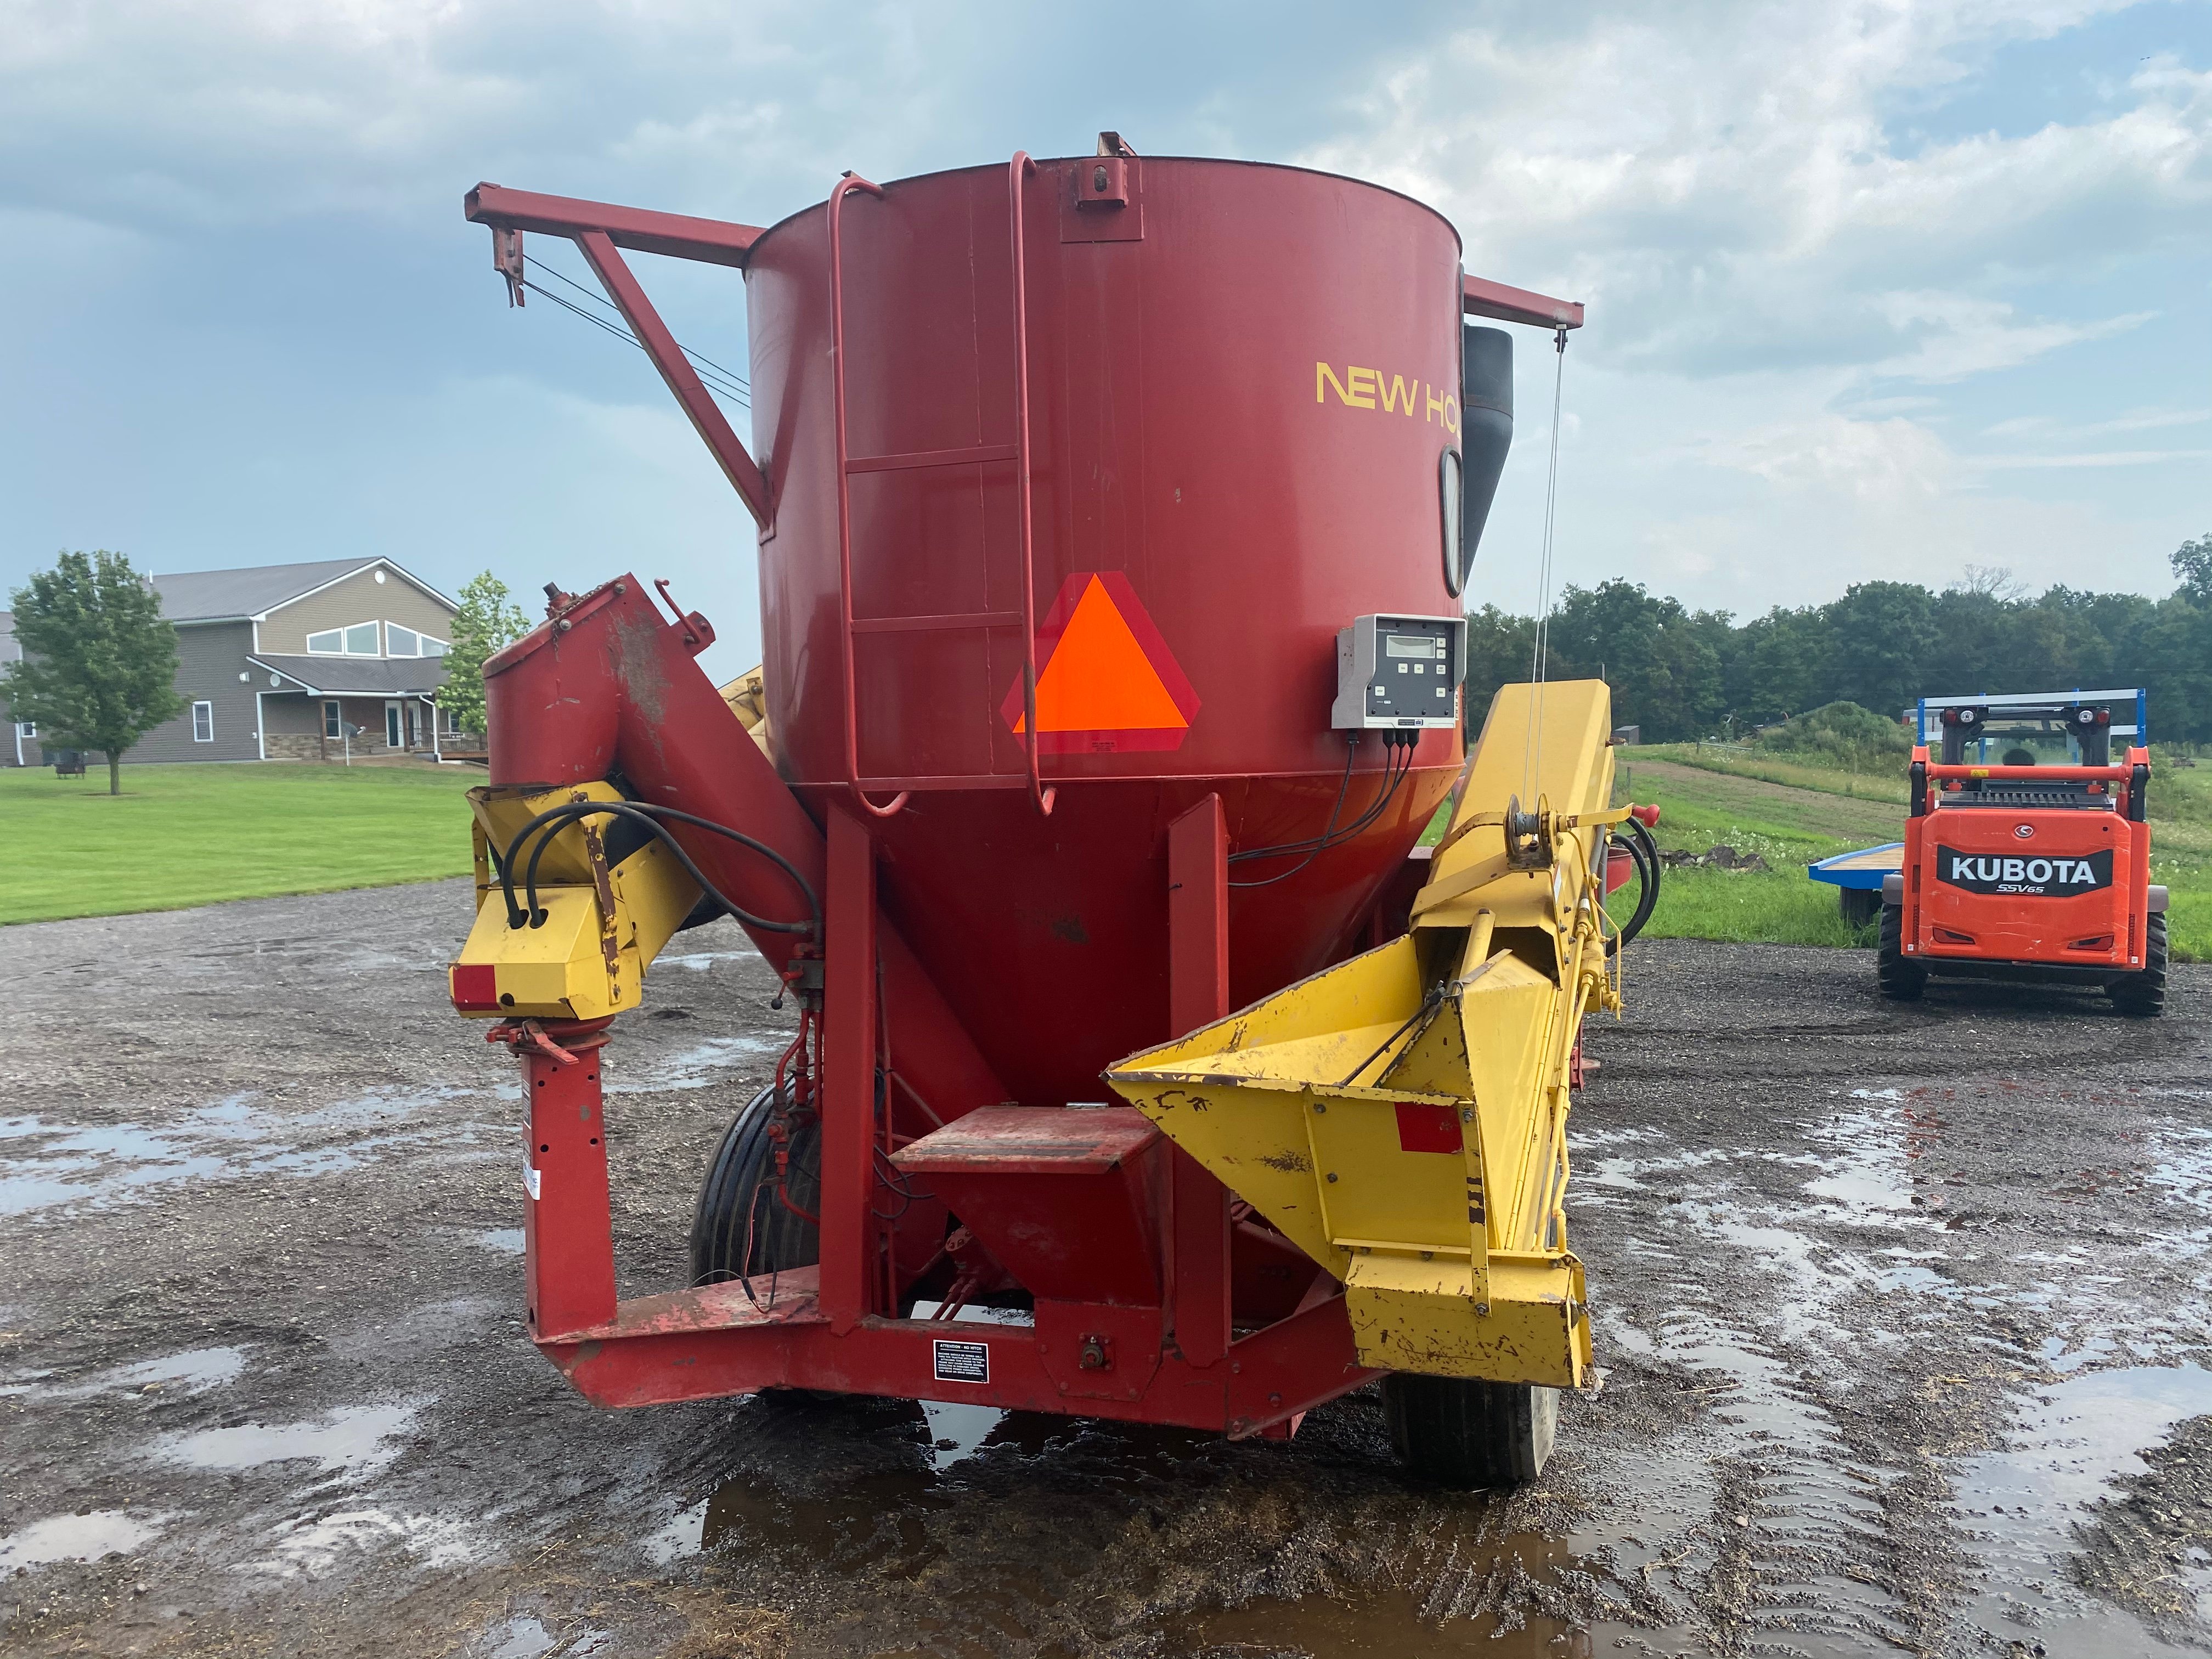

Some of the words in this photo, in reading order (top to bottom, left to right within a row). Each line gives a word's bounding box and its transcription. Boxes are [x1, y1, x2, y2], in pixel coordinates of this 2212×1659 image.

[1317, 362, 1418, 416] NEW
[1952, 857, 2097, 884] KUBOTA
[1996, 884, 2045, 893] SSV65
